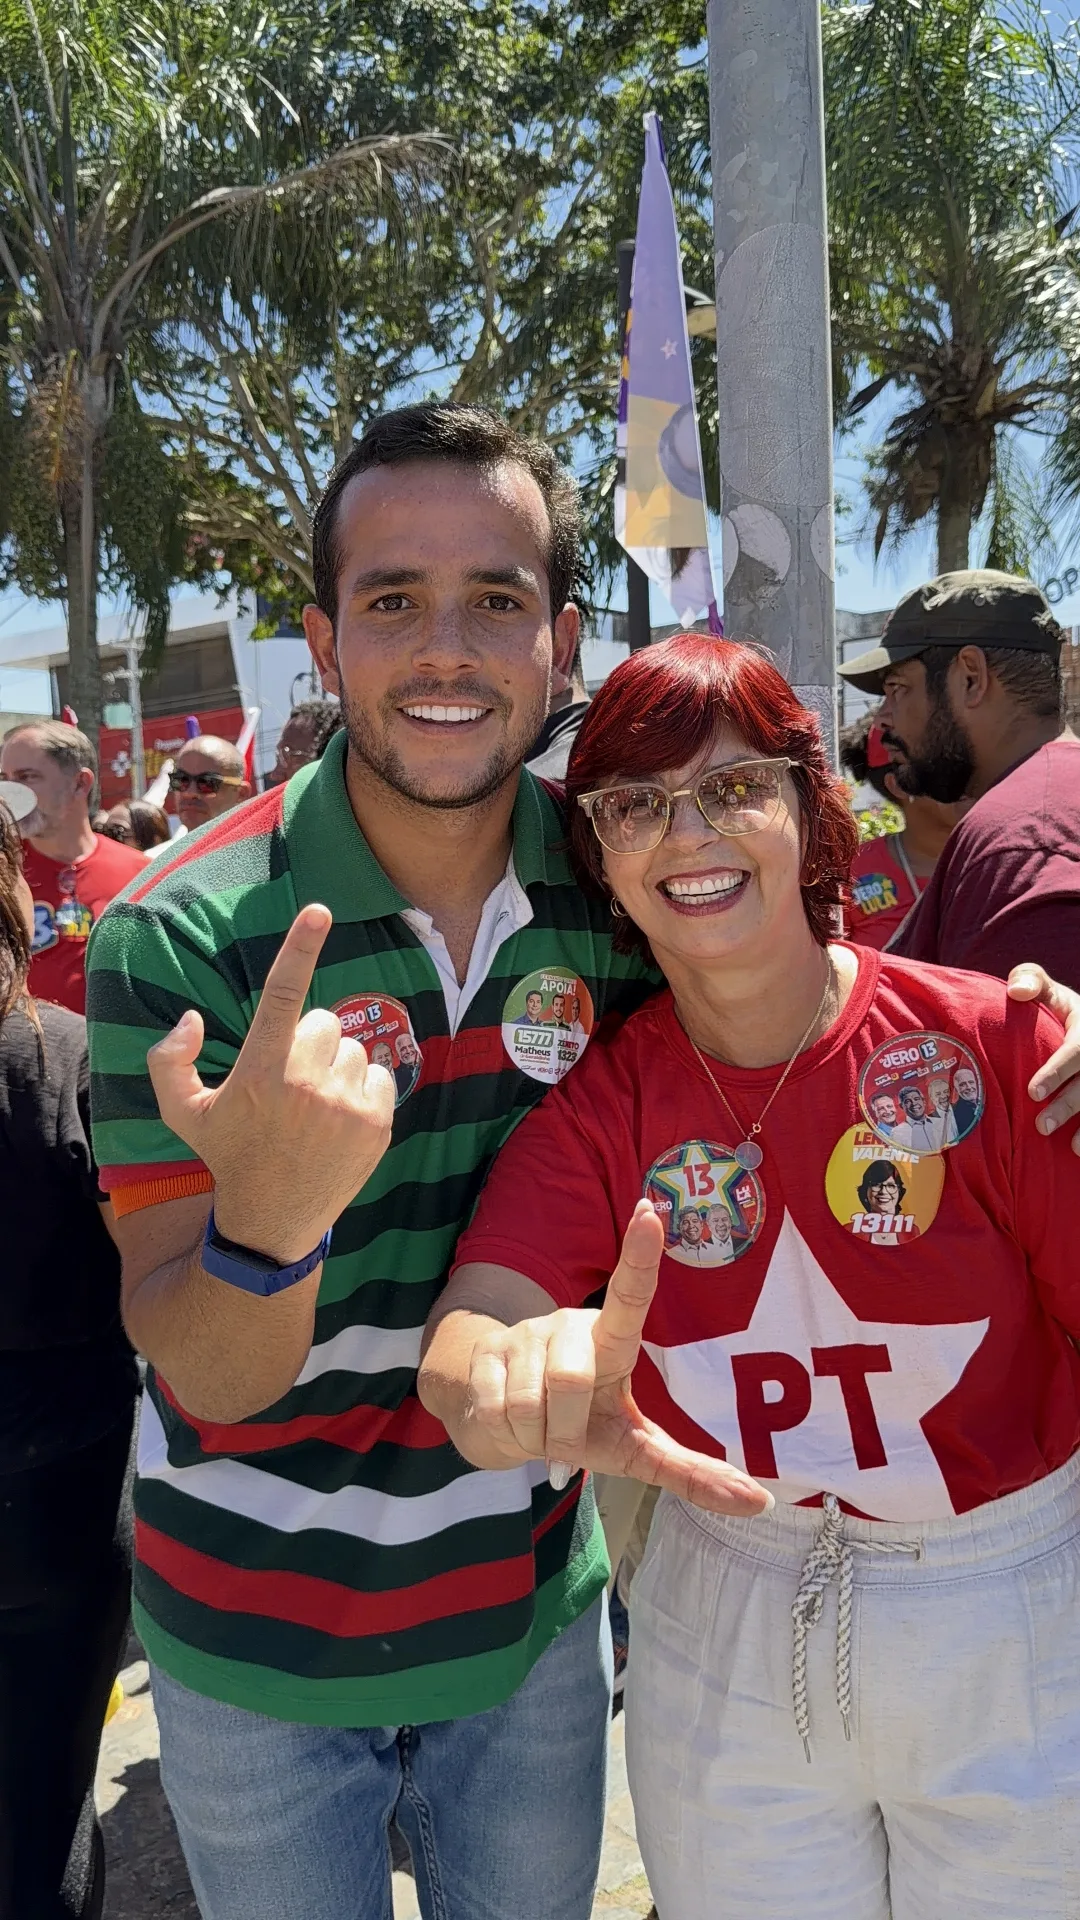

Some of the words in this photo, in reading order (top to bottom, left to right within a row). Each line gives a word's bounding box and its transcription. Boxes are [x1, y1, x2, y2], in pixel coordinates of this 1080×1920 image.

[540, 980, 577, 996] APOIA!
[341, 1010, 366, 1030] ERO
[367, 1004, 382, 1021] 13
[517, 1030, 553, 1046] 15777
[515, 1046, 551, 1057] Matheus
[557, 1049, 577, 1062] 1323
[879, 1047, 919, 1068] JERO
[921, 1042, 937, 1058] 13
[852, 1147, 920, 1164] VALENTE
[683, 1163, 716, 1197] 13
[654, 1200, 673, 1212] ERO
[851, 1213, 915, 1234] 13111
[731, 1343, 893, 1479] PT
